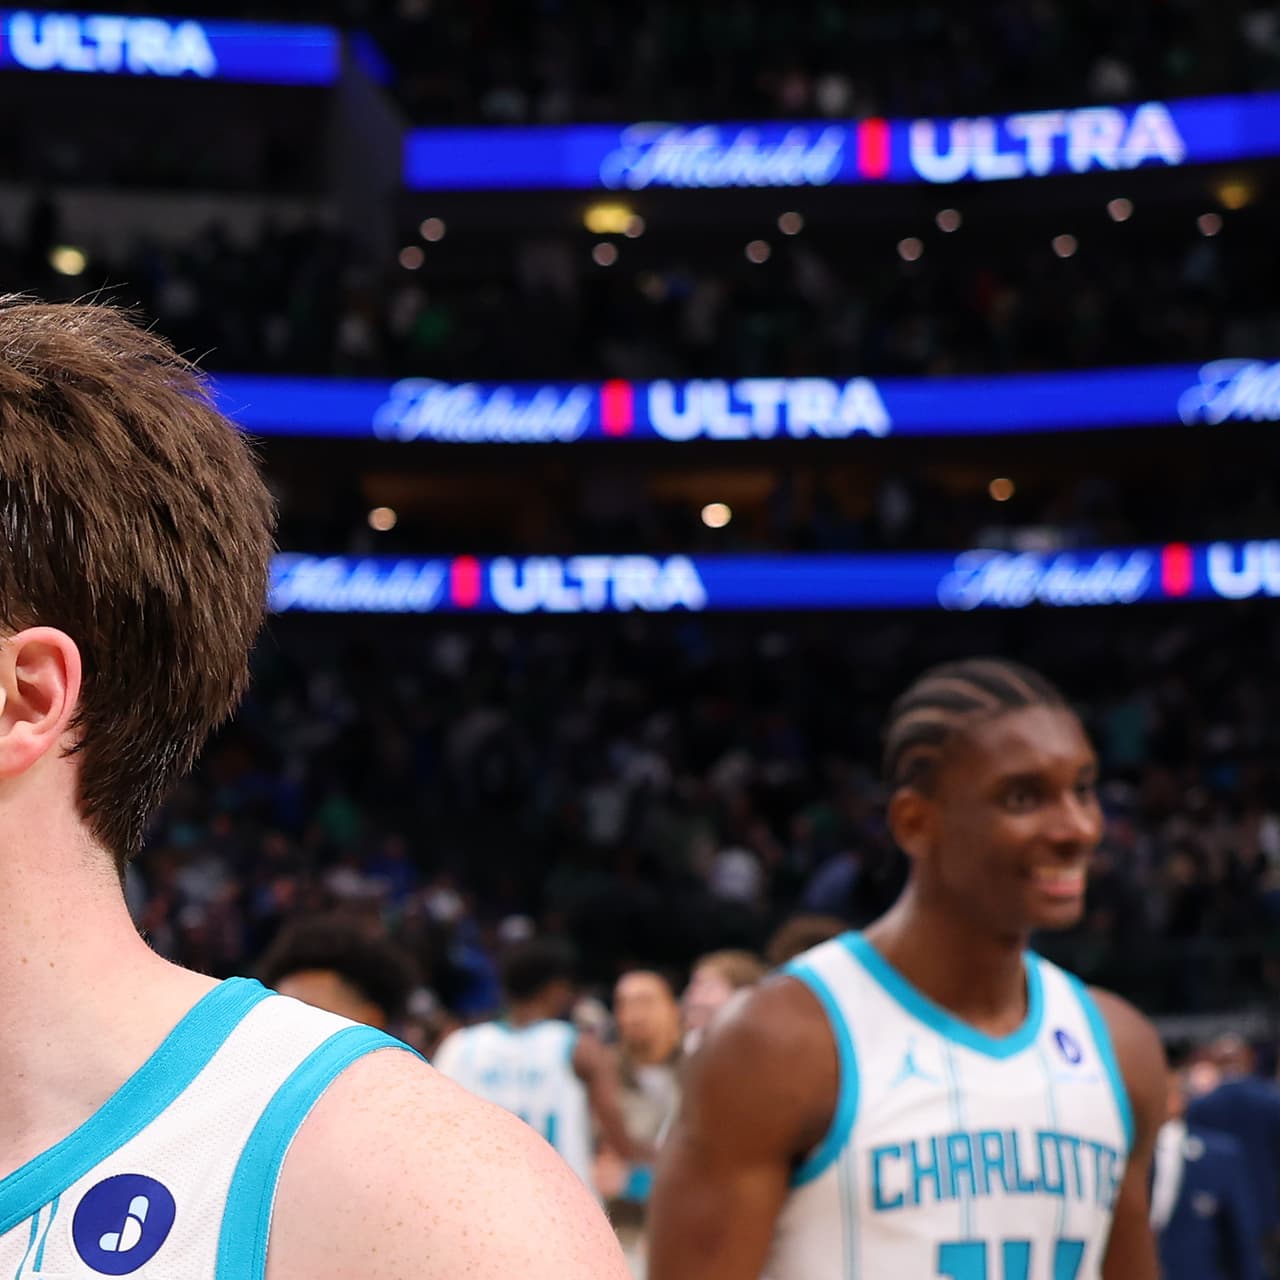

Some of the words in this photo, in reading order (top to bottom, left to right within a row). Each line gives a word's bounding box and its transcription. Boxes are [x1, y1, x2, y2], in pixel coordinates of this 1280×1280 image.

[8, 10, 218, 78] ULTRA
[910, 102, 1185, 183] ULTRA
[649, 378, 892, 441] ULTRA
[491, 555, 706, 613] ULTRA
